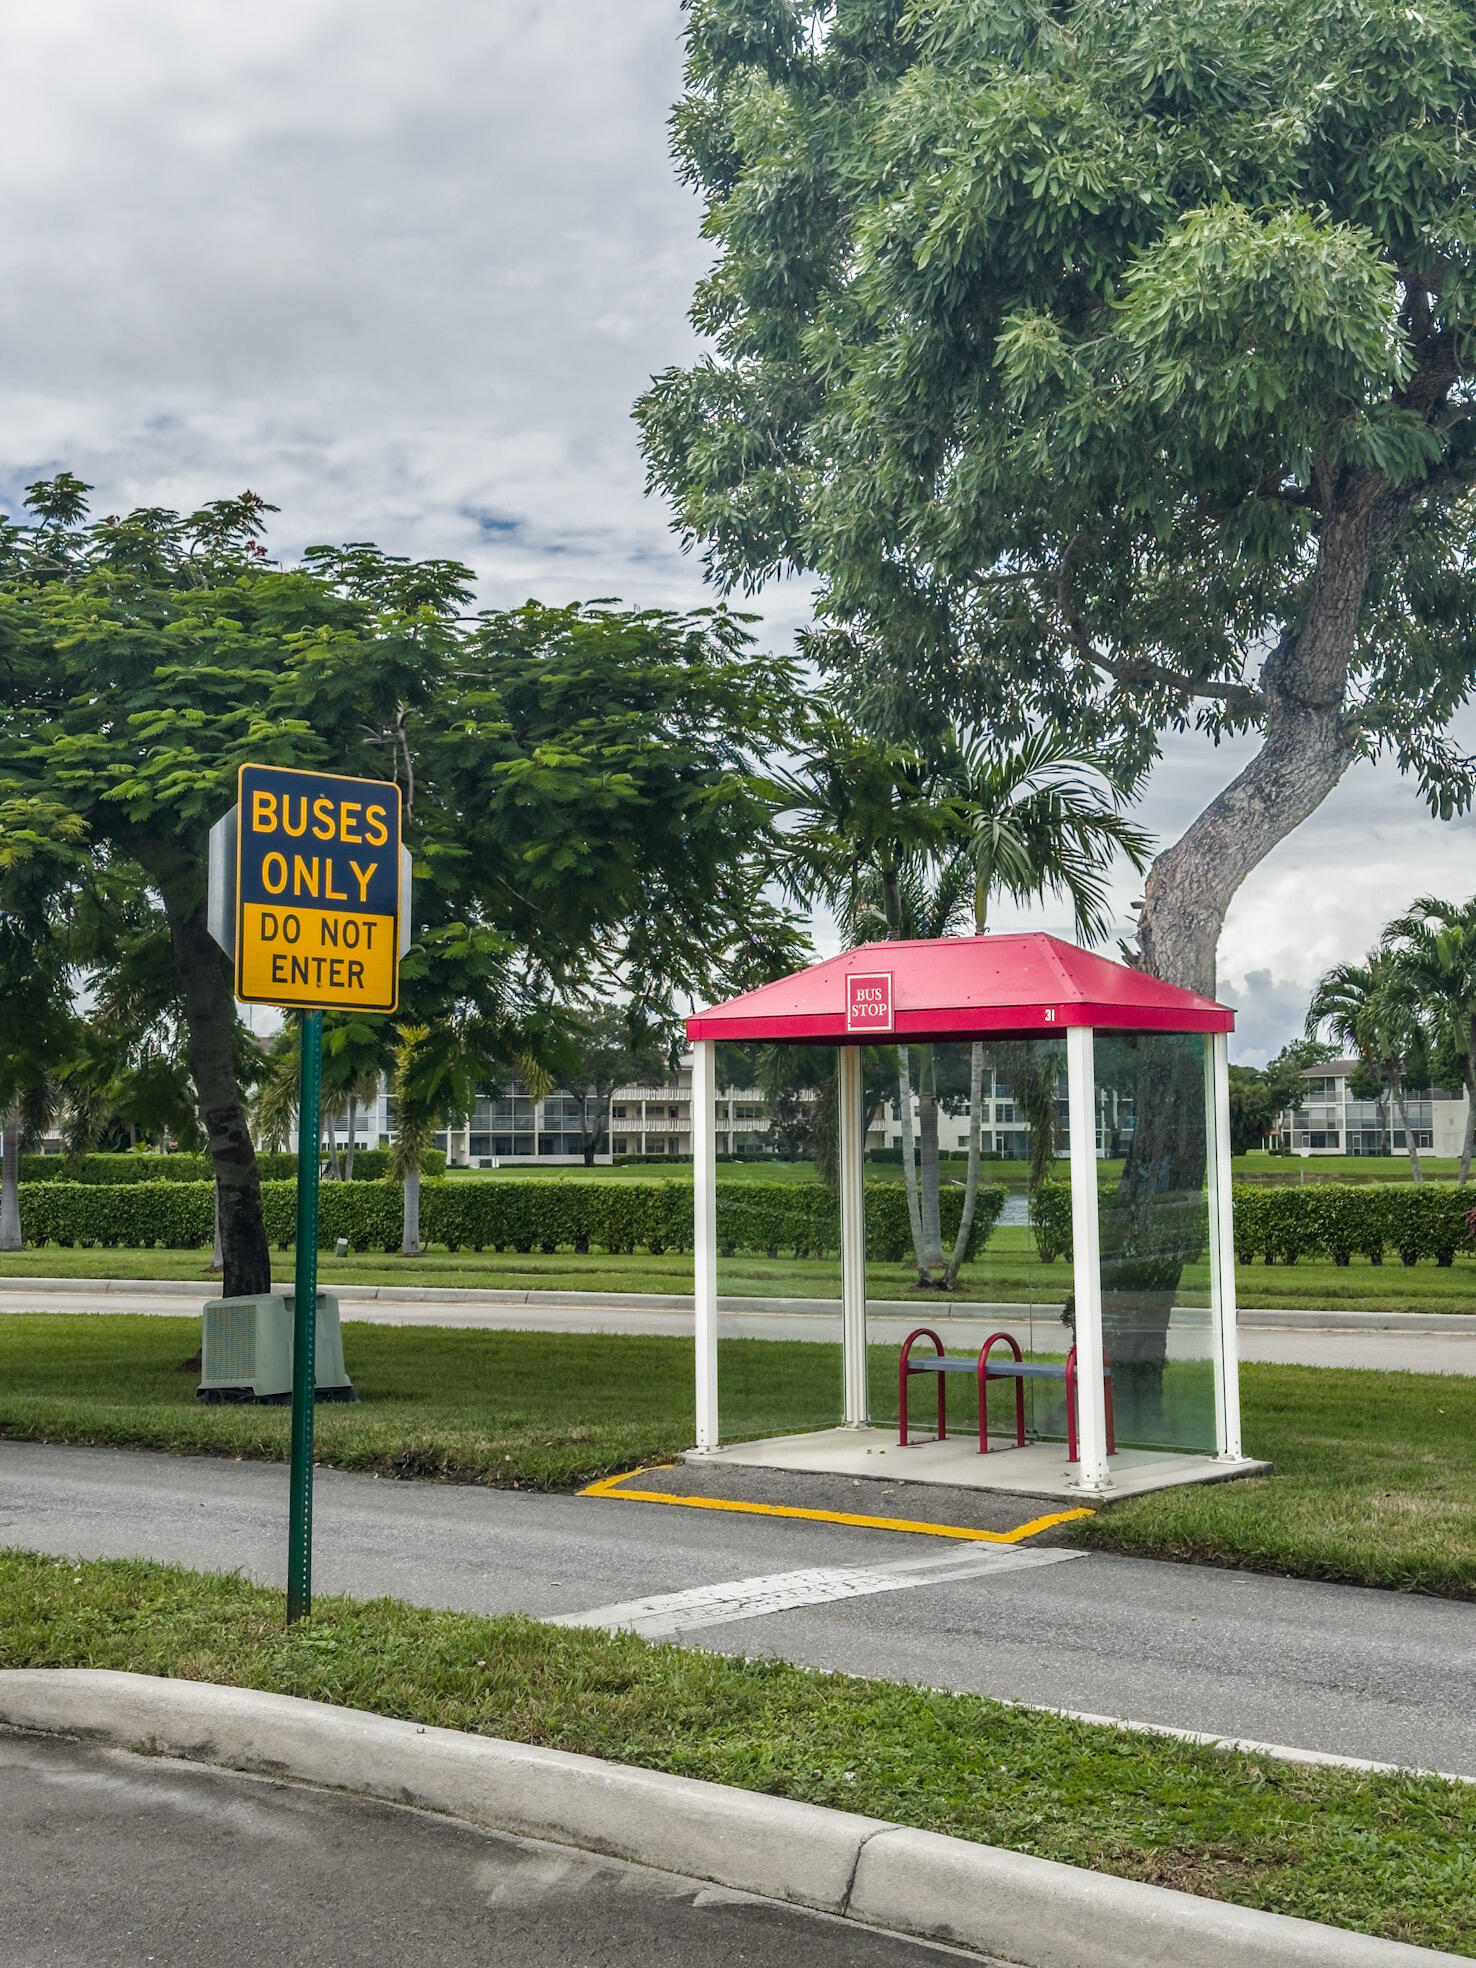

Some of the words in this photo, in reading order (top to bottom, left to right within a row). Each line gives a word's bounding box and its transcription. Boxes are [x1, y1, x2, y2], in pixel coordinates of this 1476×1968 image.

[252, 790, 389, 846] BUSES
[261, 851, 378, 902] ONLY
[260, 912, 300, 944] DO
[321, 917, 377, 950] NOT
[271, 954, 365, 989] ENTER
[852, 1003, 887, 1017] STOP
[856, 988, 882, 1001] BUS
[1045, 1008, 1055, 1021] 31
